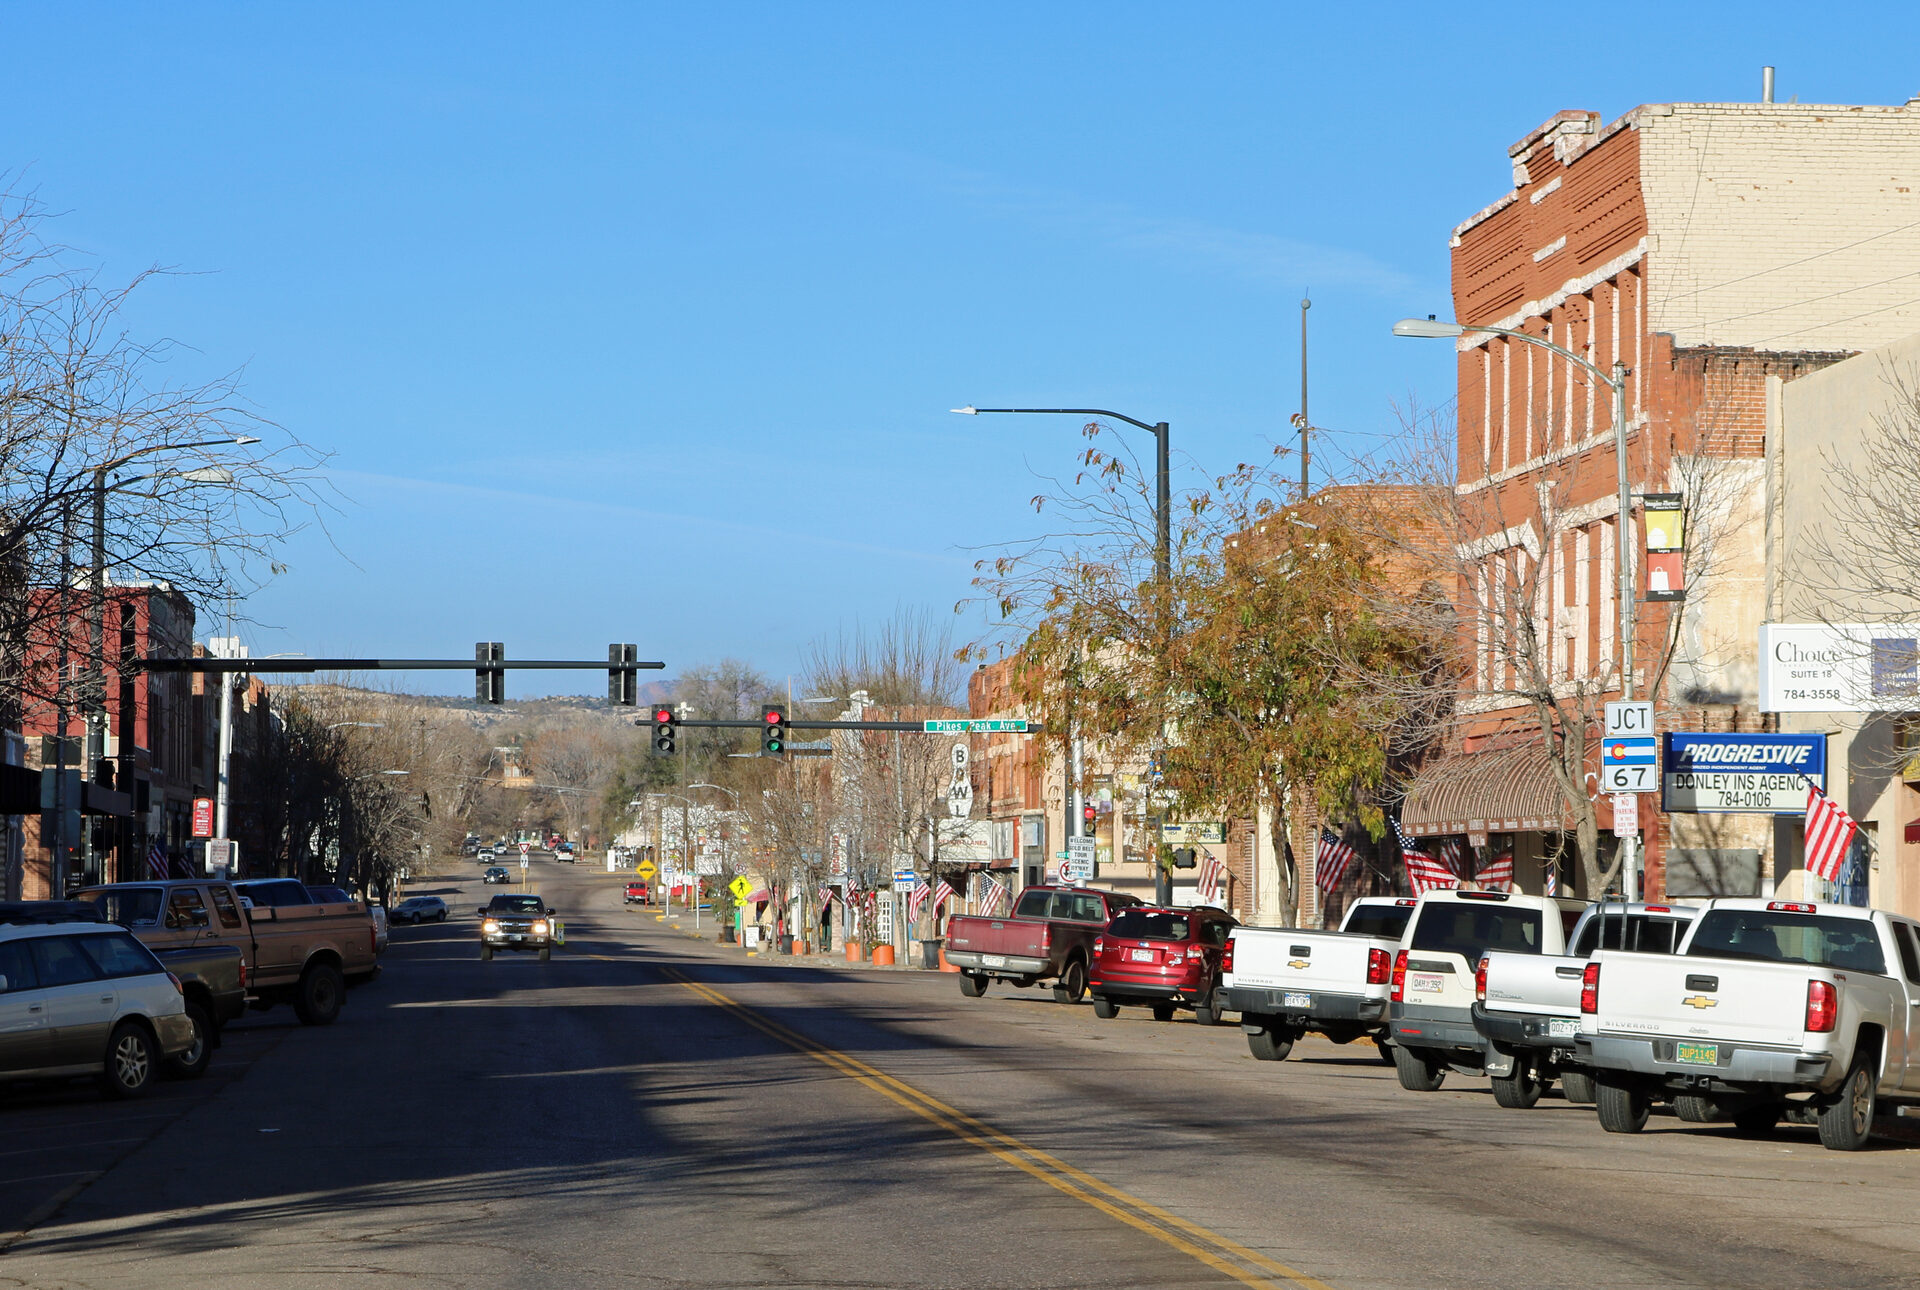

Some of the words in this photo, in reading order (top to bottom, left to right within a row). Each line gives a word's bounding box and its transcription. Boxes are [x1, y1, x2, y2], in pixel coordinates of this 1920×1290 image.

[1775, 641, 1842, 662] Choice
[1791, 670, 1819, 679] SUITE
[1822, 670, 1832, 678] 18
[1783, 689, 1841, 700] 784-3558
[936, 721, 962, 731] Pikes
[970, 721, 992, 731] Peak
[1000, 721, 1016, 731] Ave
[1611, 708, 1648, 730] JCT
[1680, 743, 1813, 764] PROGRESSIVE
[1613, 767, 1647, 787] 67
[1676, 774, 1730, 790] DONLEY
[1734, 774, 1755, 790] INS
[1718, 792, 1771, 807] 784-0106
[898, 882, 911, 891] 115
[1605, 1021, 1660, 1031] SILVERADO
